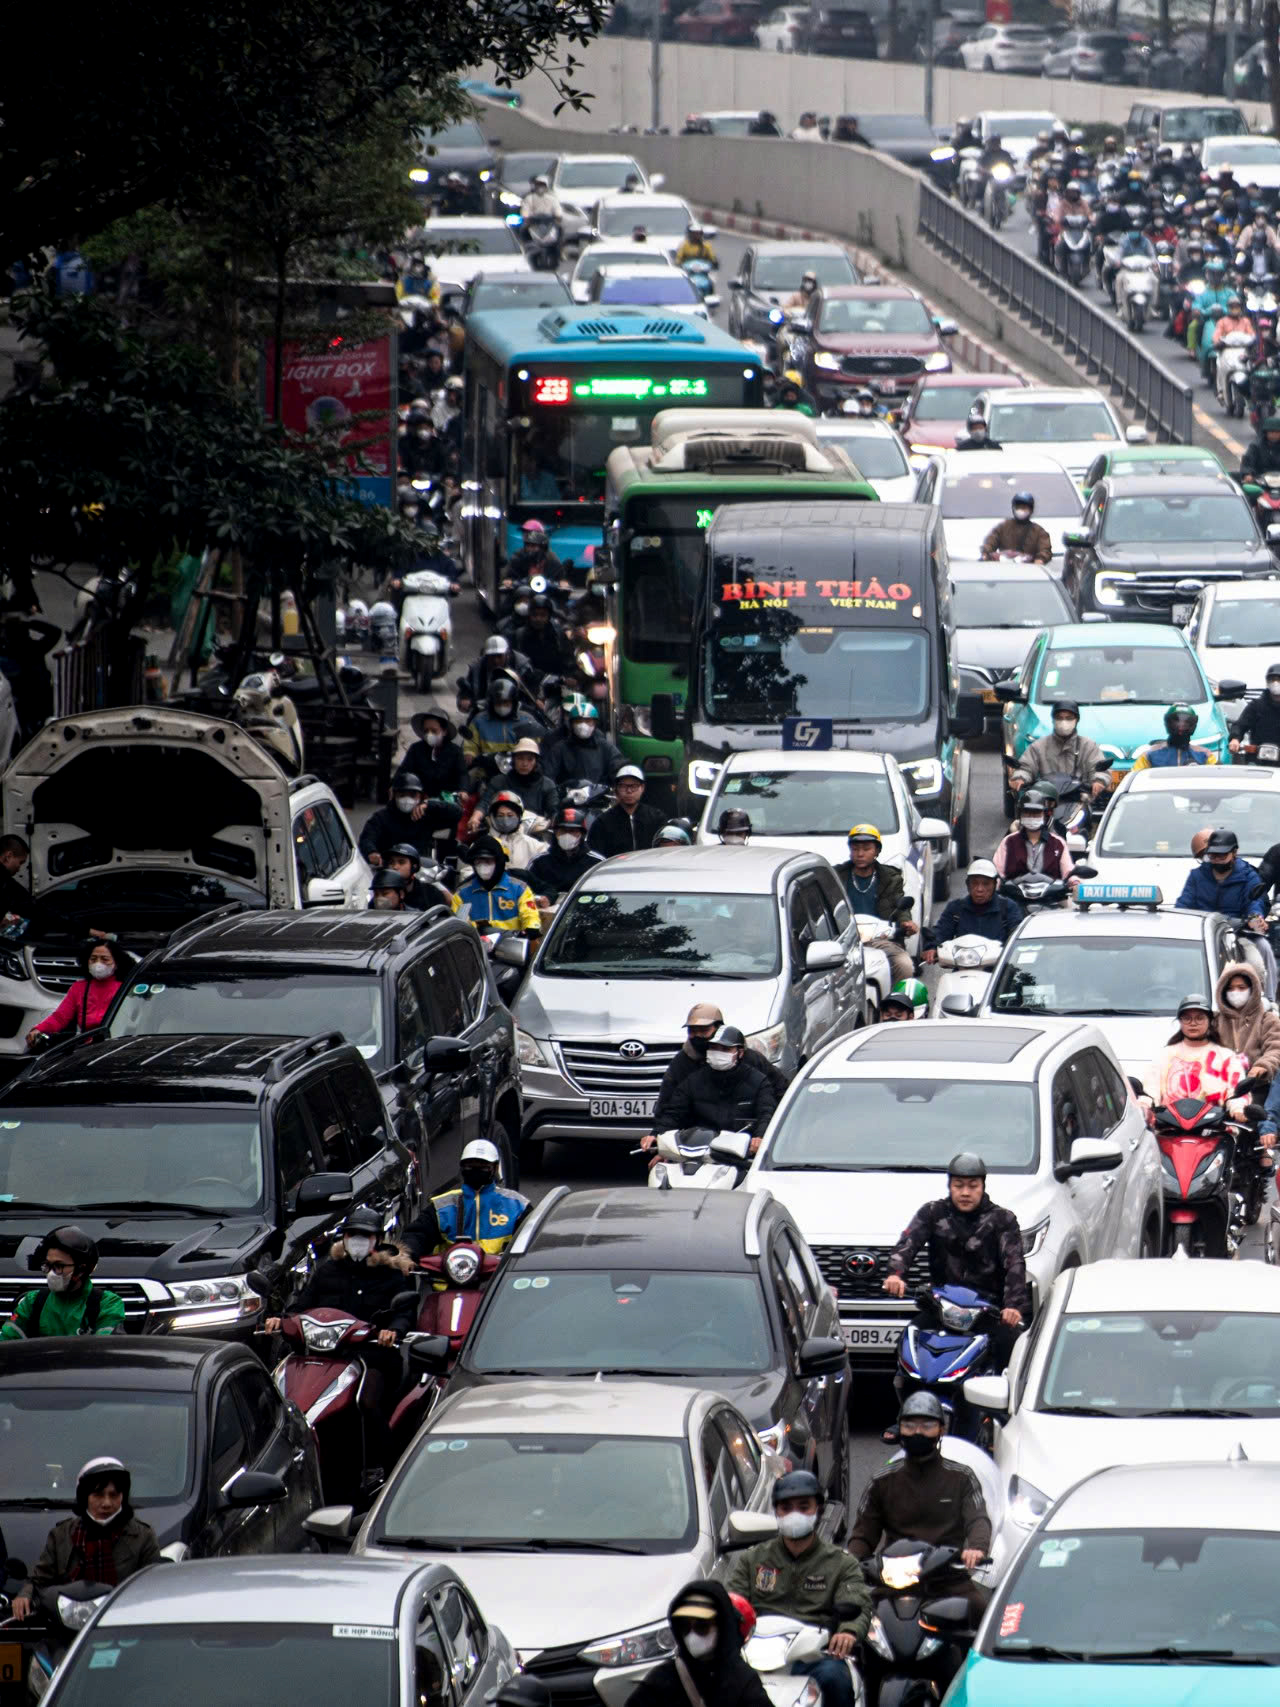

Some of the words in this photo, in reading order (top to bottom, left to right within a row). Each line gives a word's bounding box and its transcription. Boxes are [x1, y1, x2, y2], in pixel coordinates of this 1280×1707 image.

[282, 364, 333, 381] IGHT
[333, 361, 376, 378] BOX
[722, 578, 807, 601] BÌNH
[815, 577, 912, 600] THẢO
[739, 599, 758, 610] HÀ
[864, 599, 897, 610] NAM
[794, 721, 821, 747] G7
[1083, 885, 1105, 898] TAXI
[1105, 885, 1129, 898] LINH
[1130, 885, 1153, 898] ANH
[498, 896, 515, 910] be
[489, 1208, 510, 1227] be
